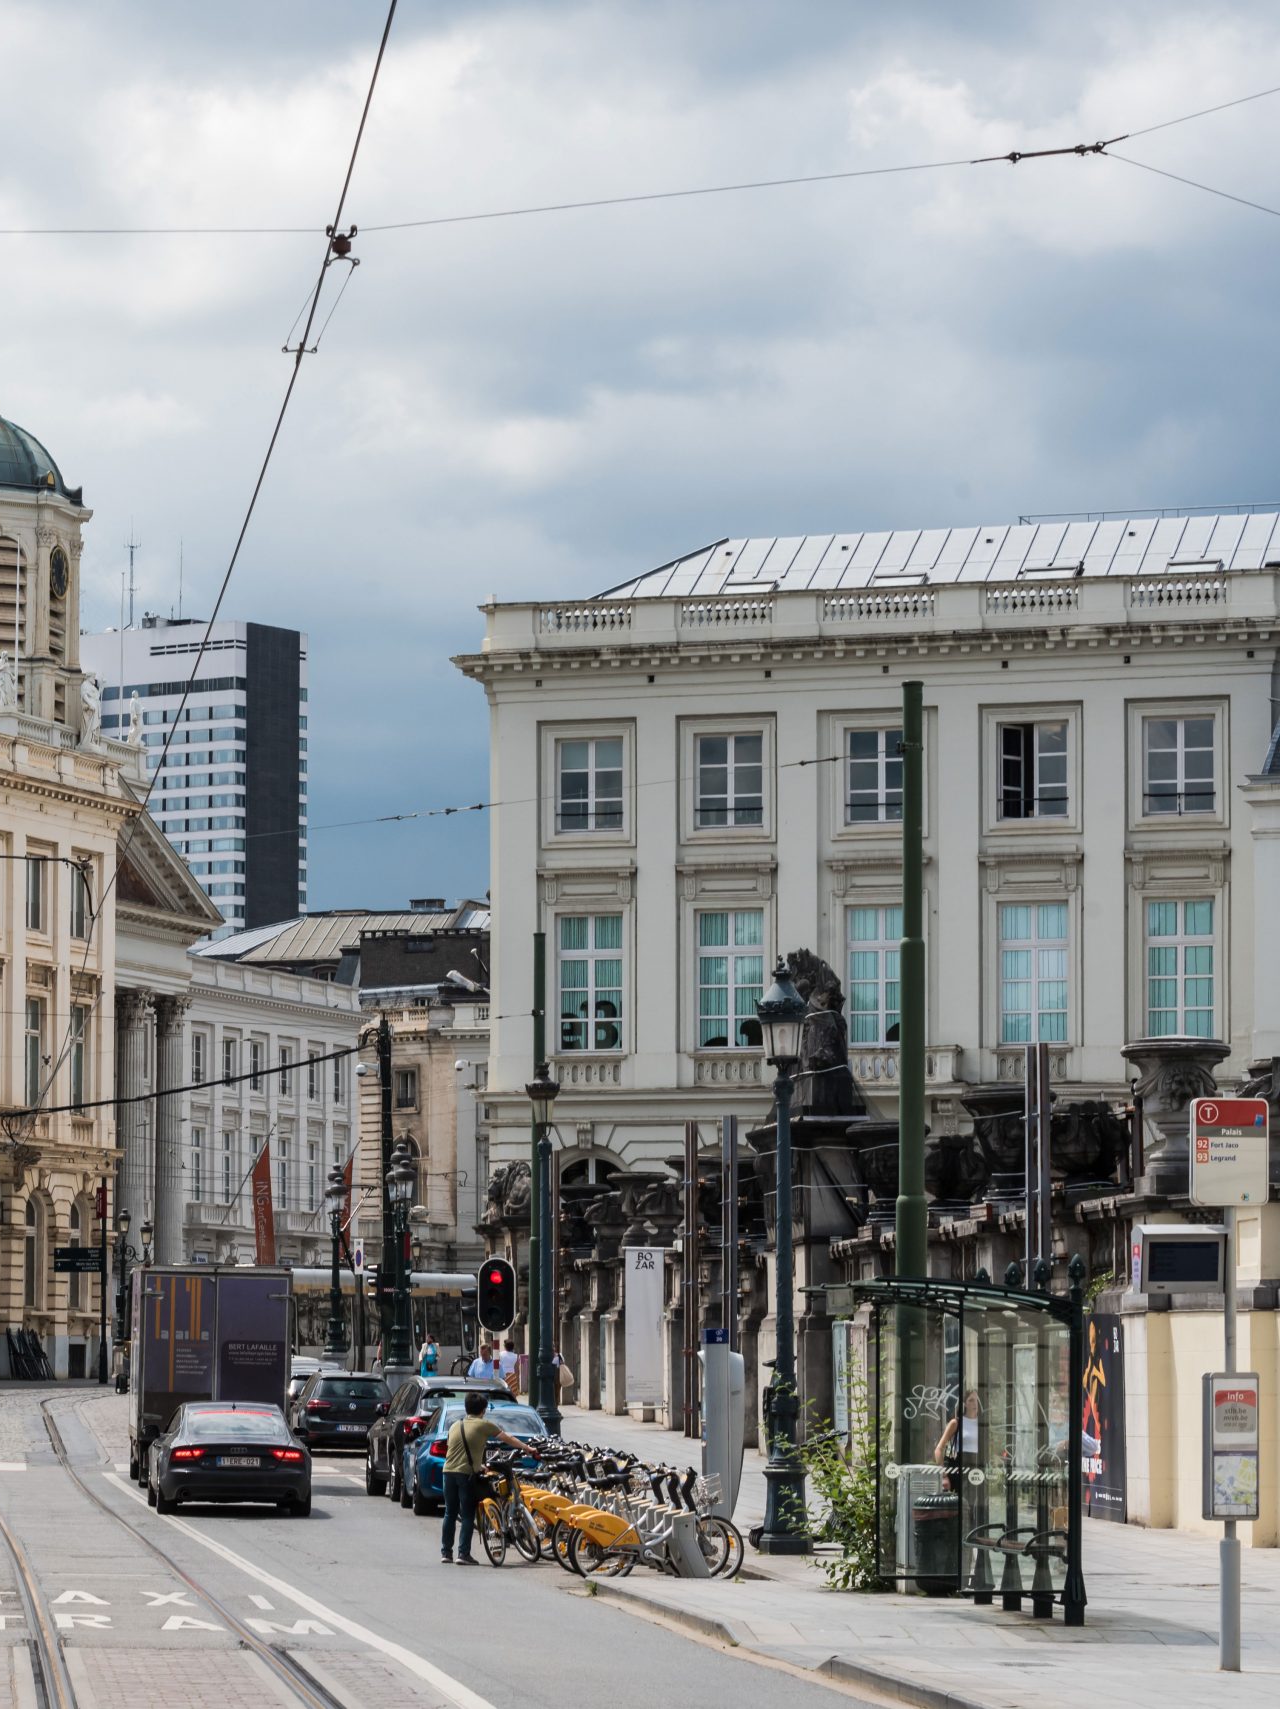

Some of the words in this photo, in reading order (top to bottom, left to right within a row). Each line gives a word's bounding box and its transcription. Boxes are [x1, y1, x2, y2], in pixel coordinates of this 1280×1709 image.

[1221, 1128, 1242, 1136] Palais
[1197, 1139, 1208, 1149] 92
[1197, 1152, 1208, 1161] 93
[1210, 1154, 1237, 1163] Legrand
[637, 1252, 653, 1261] BO
[635, 1261, 655, 1270] ZAR
